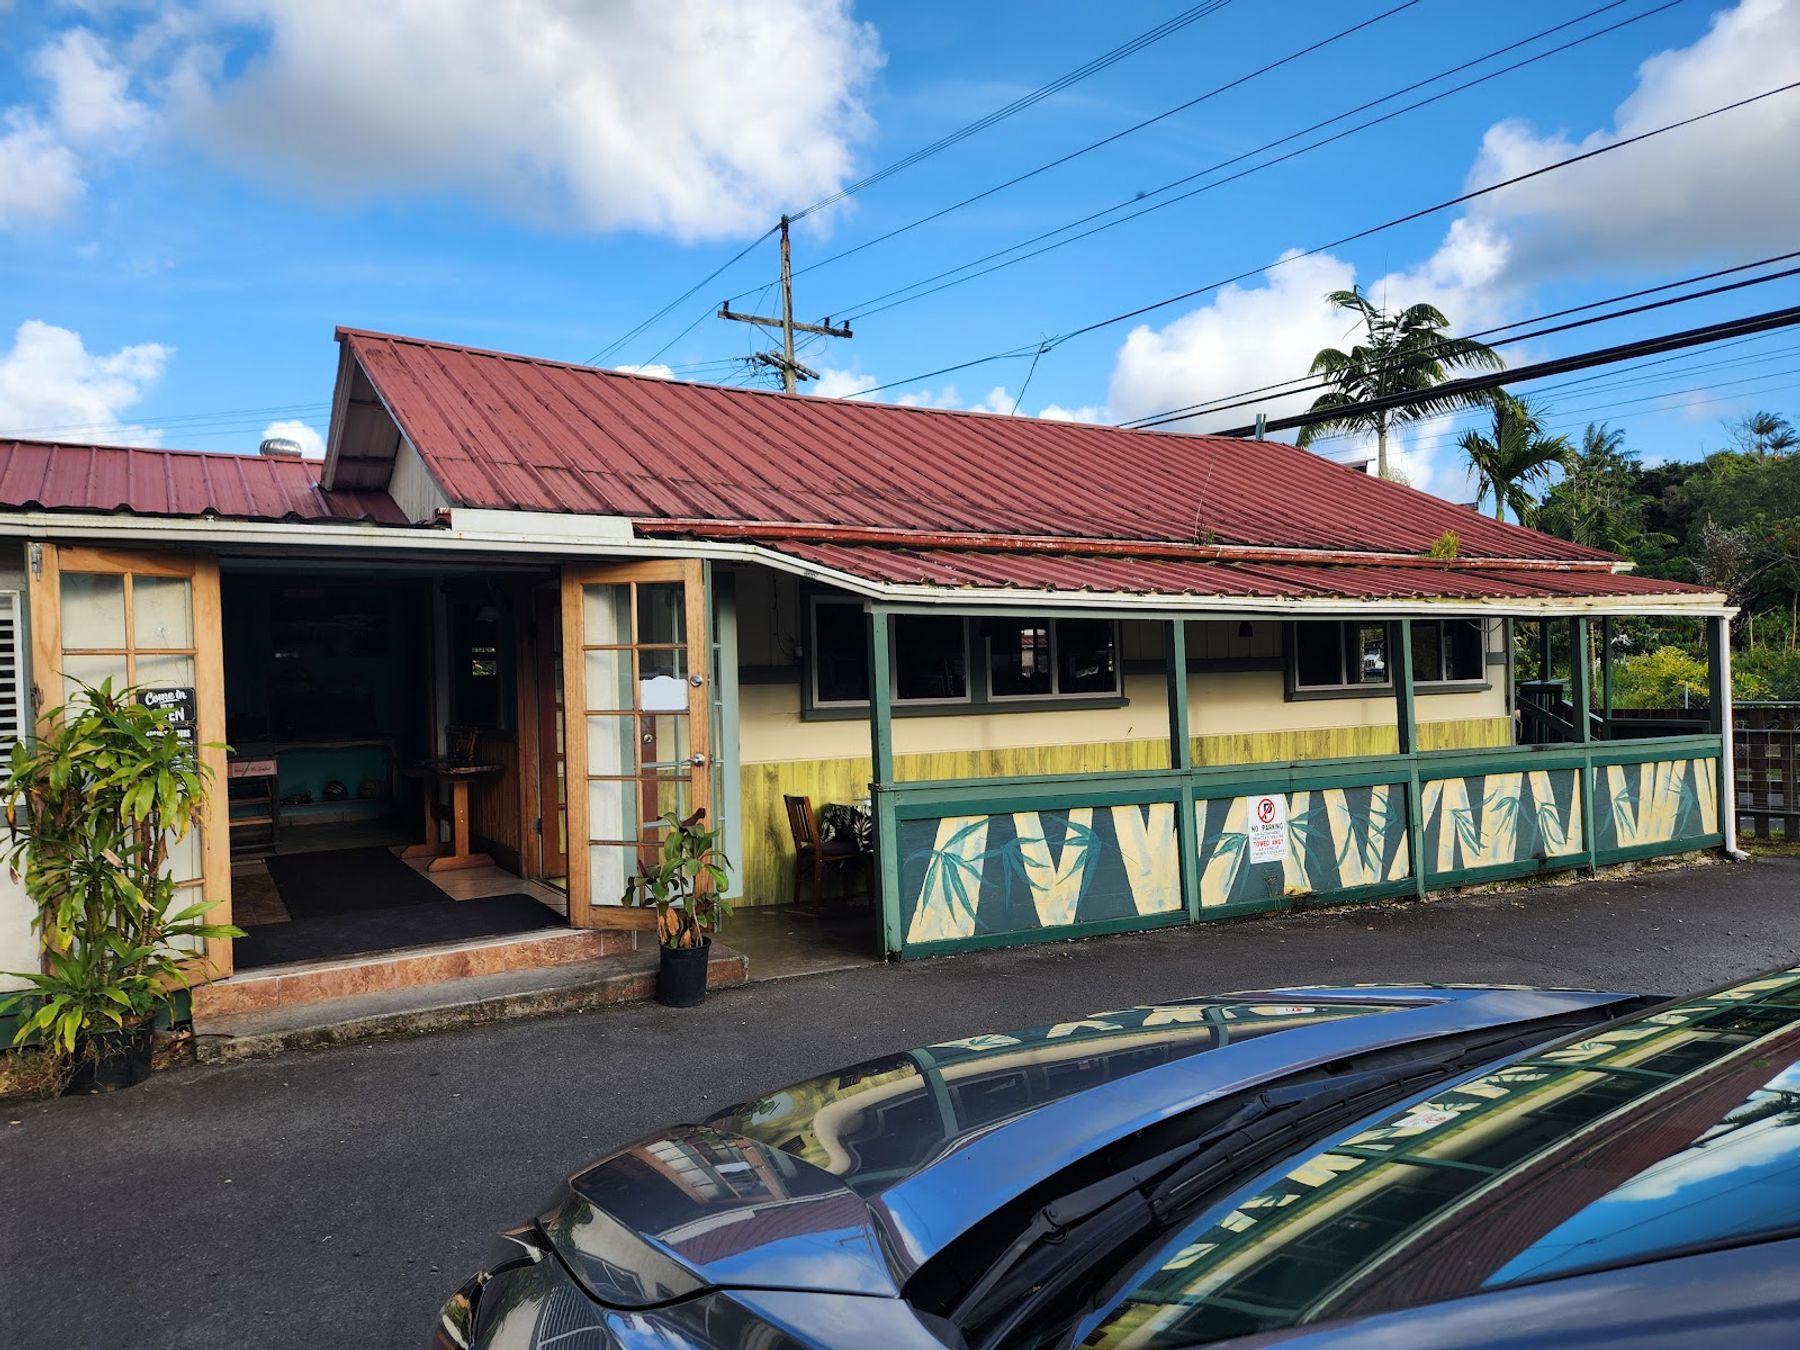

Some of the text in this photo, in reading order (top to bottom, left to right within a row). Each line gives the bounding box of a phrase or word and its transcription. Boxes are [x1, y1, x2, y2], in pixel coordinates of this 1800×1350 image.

[145, 689, 187, 705] Come in
[1262, 823, 1283, 831] PARKING
[1253, 840, 1269, 848] TOWED
